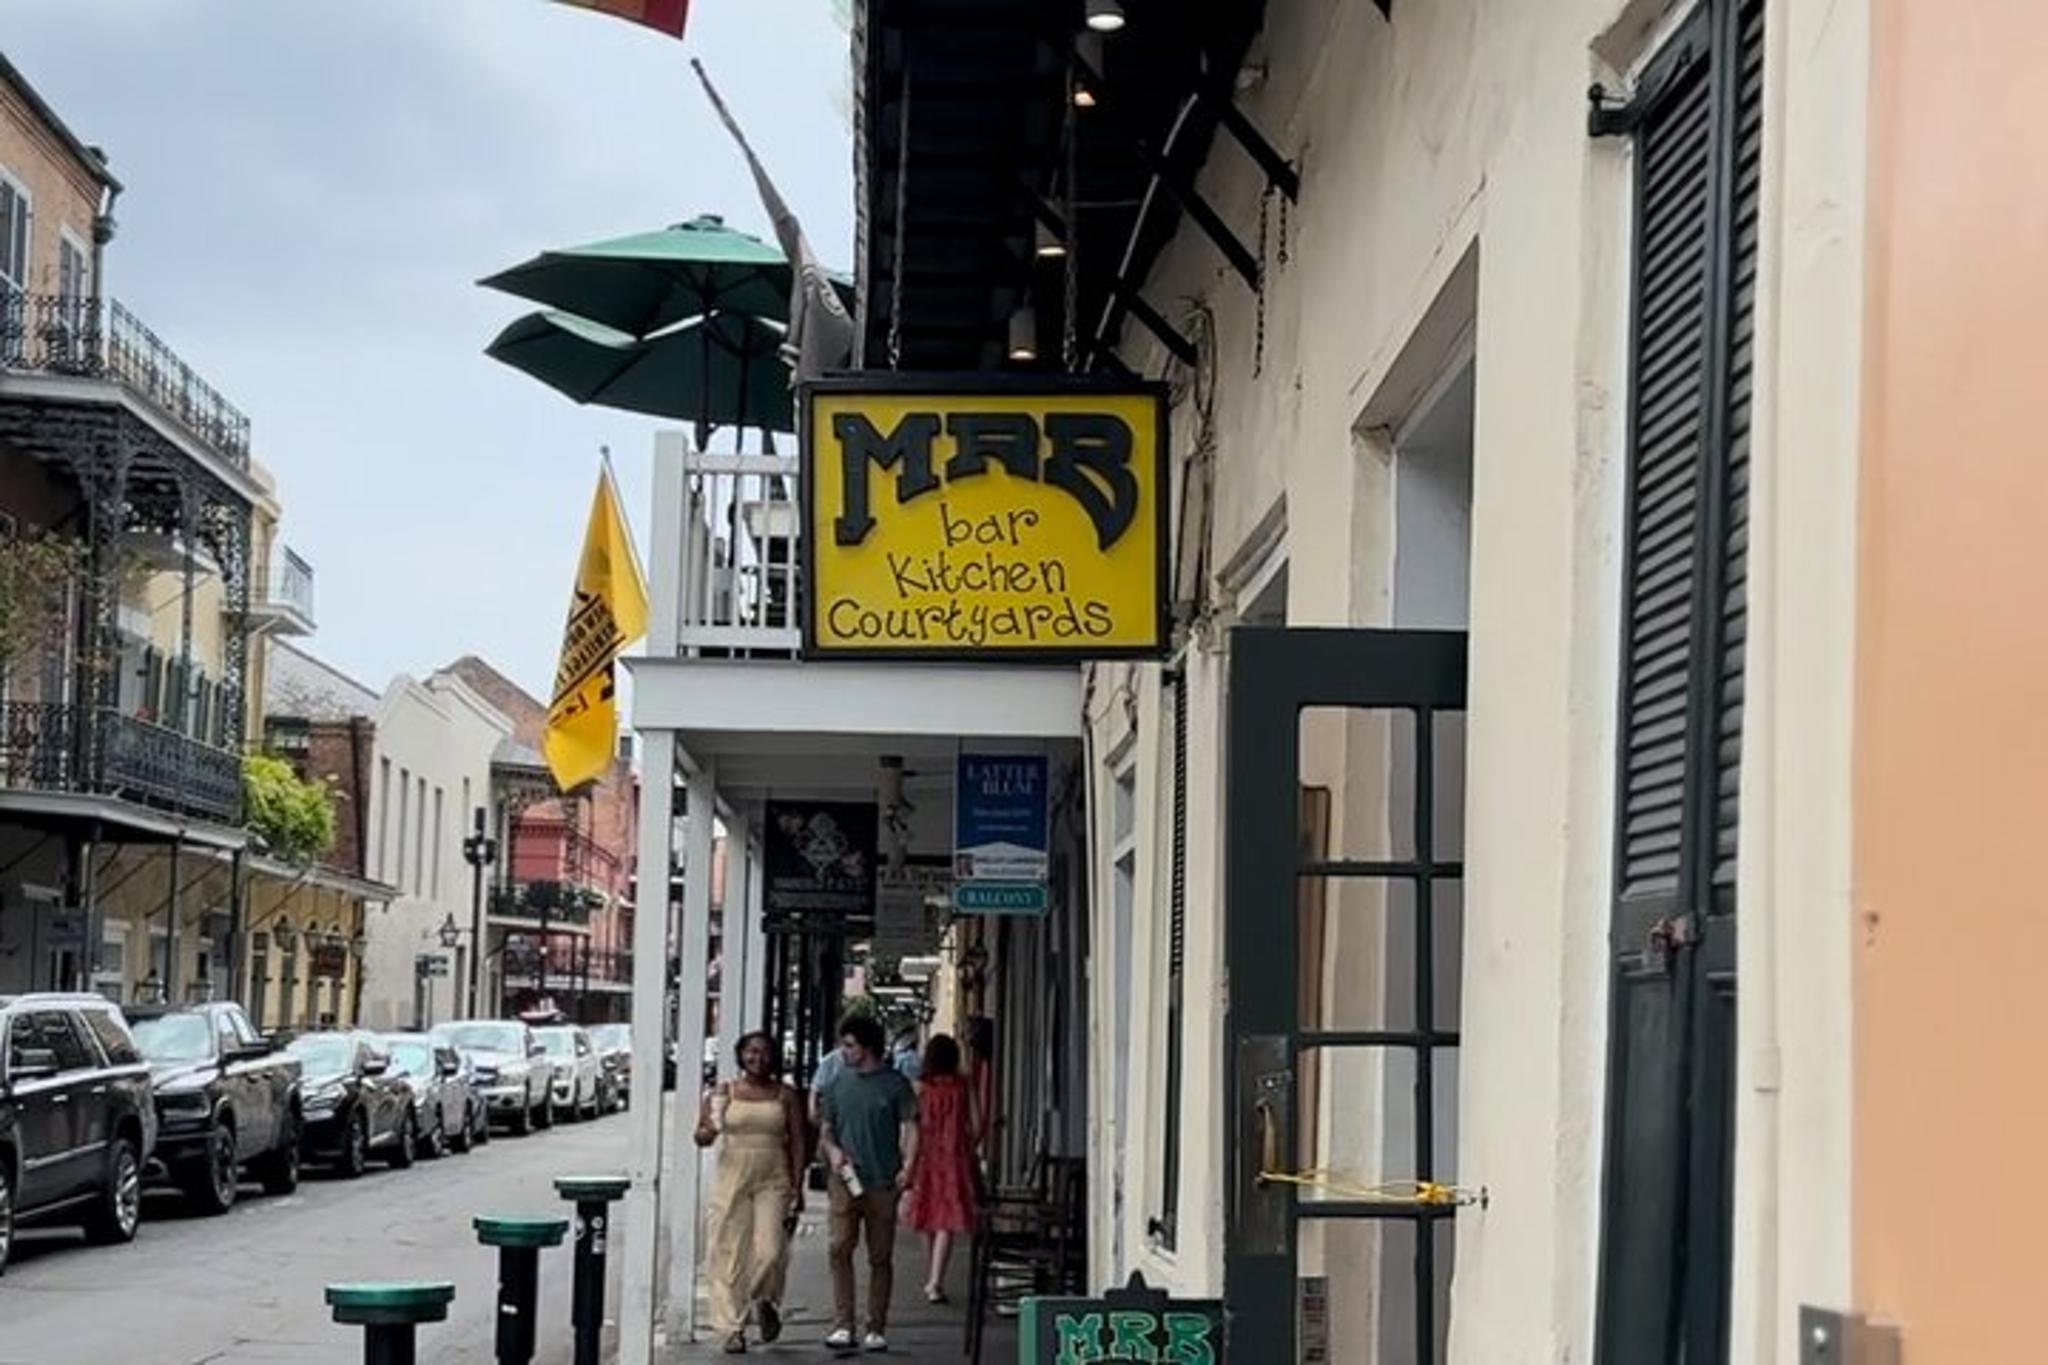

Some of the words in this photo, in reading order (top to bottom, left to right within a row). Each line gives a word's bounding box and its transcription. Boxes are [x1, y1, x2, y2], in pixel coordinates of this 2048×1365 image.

[833, 412, 1138, 551] MRB
[941, 503, 1039, 547] bar
[887, 551, 1066, 598] Kitchen
[828, 598, 1113, 646] Courtyards
[1056, 1311, 1215, 1365] MRB
